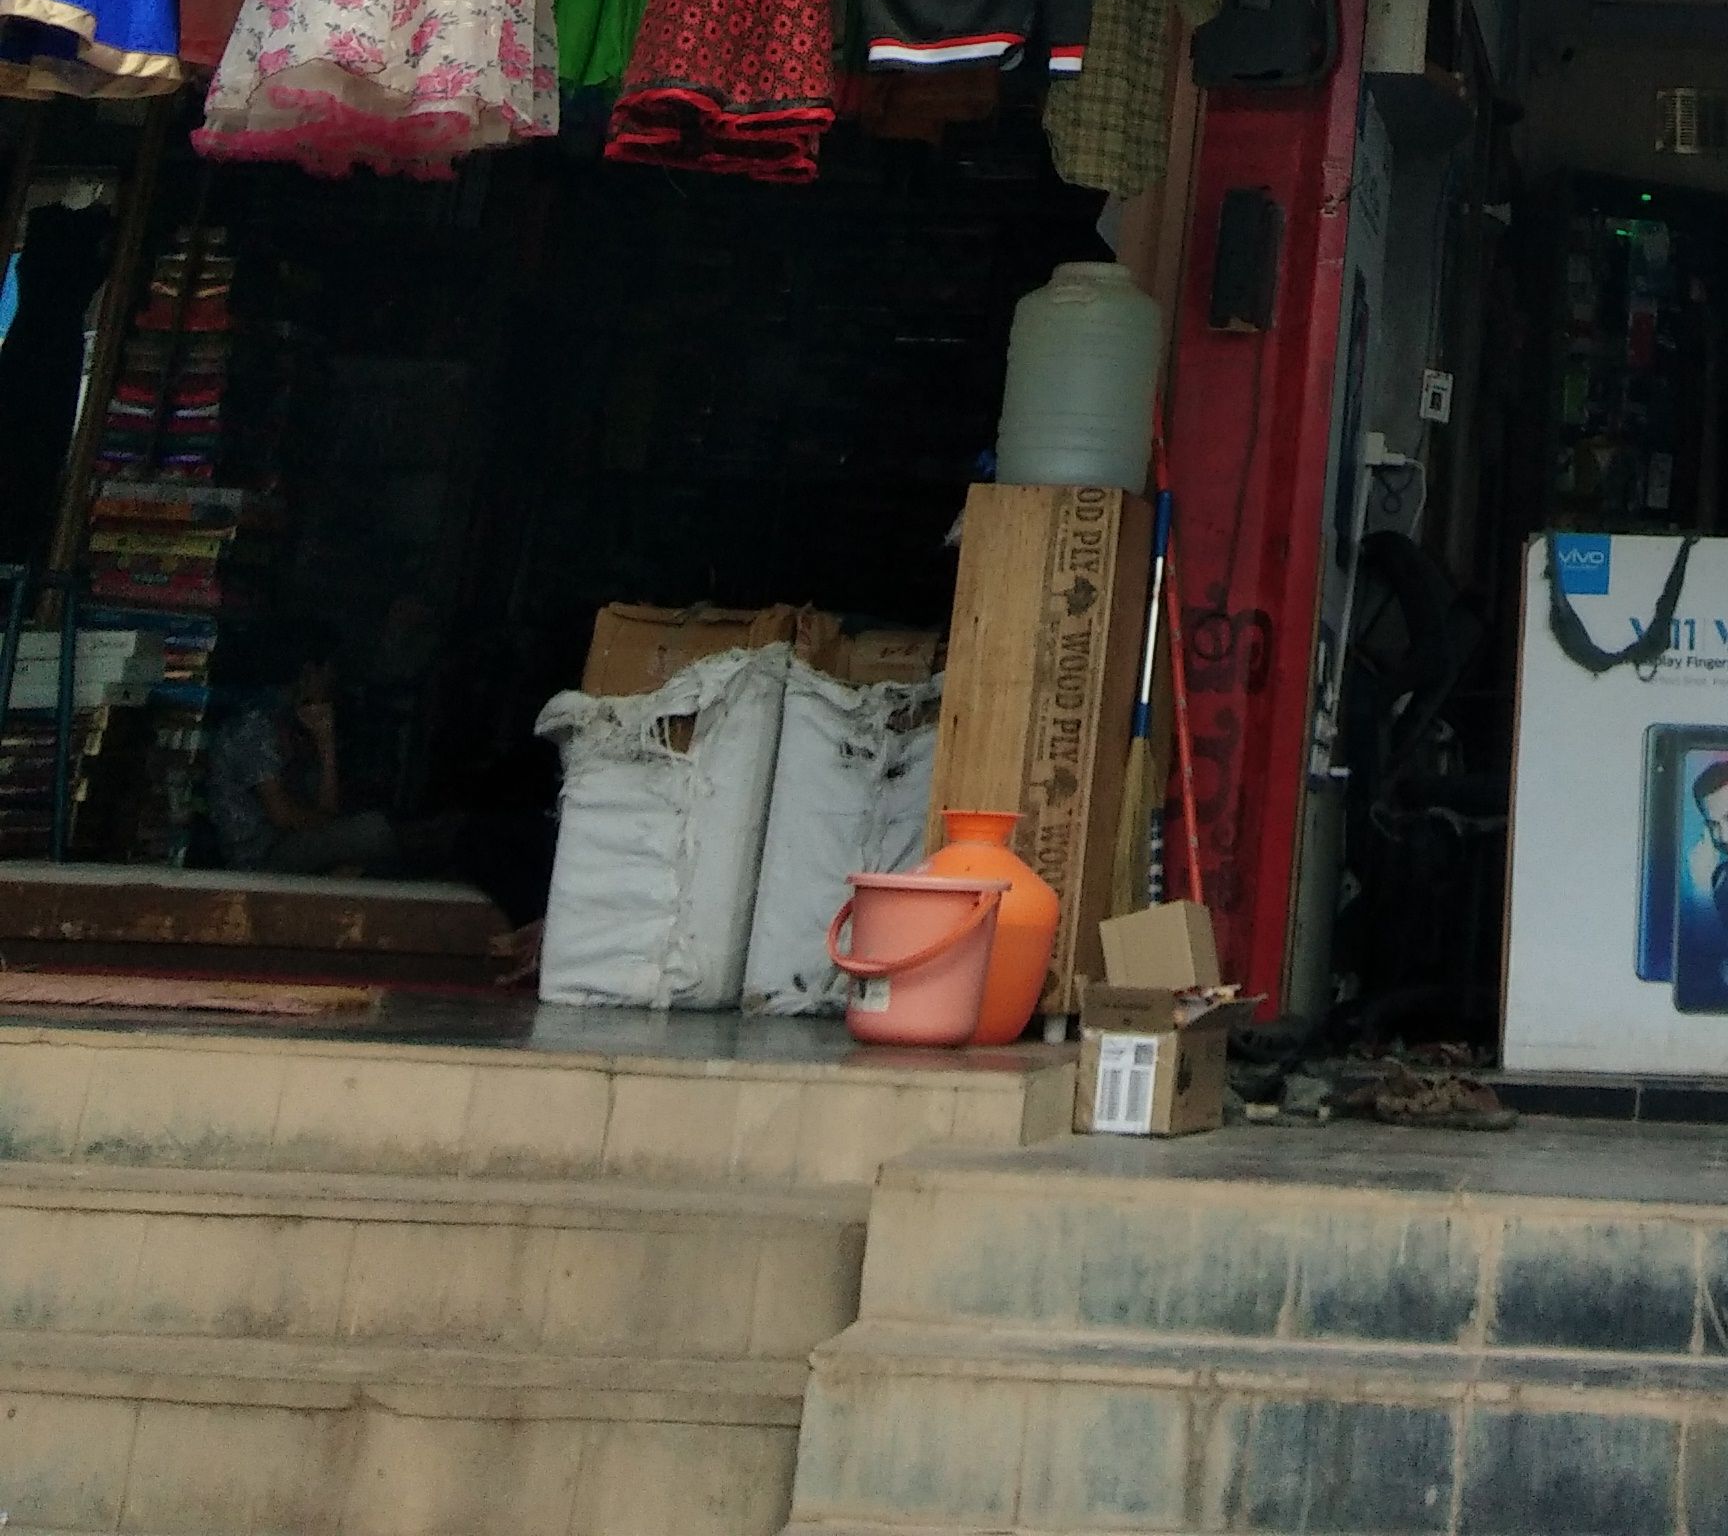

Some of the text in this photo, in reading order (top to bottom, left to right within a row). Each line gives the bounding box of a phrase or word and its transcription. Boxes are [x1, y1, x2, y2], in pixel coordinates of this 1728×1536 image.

[1558, 549, 1605, 565] vivo
[1049, 630, 1091, 765] WOOD PLY
